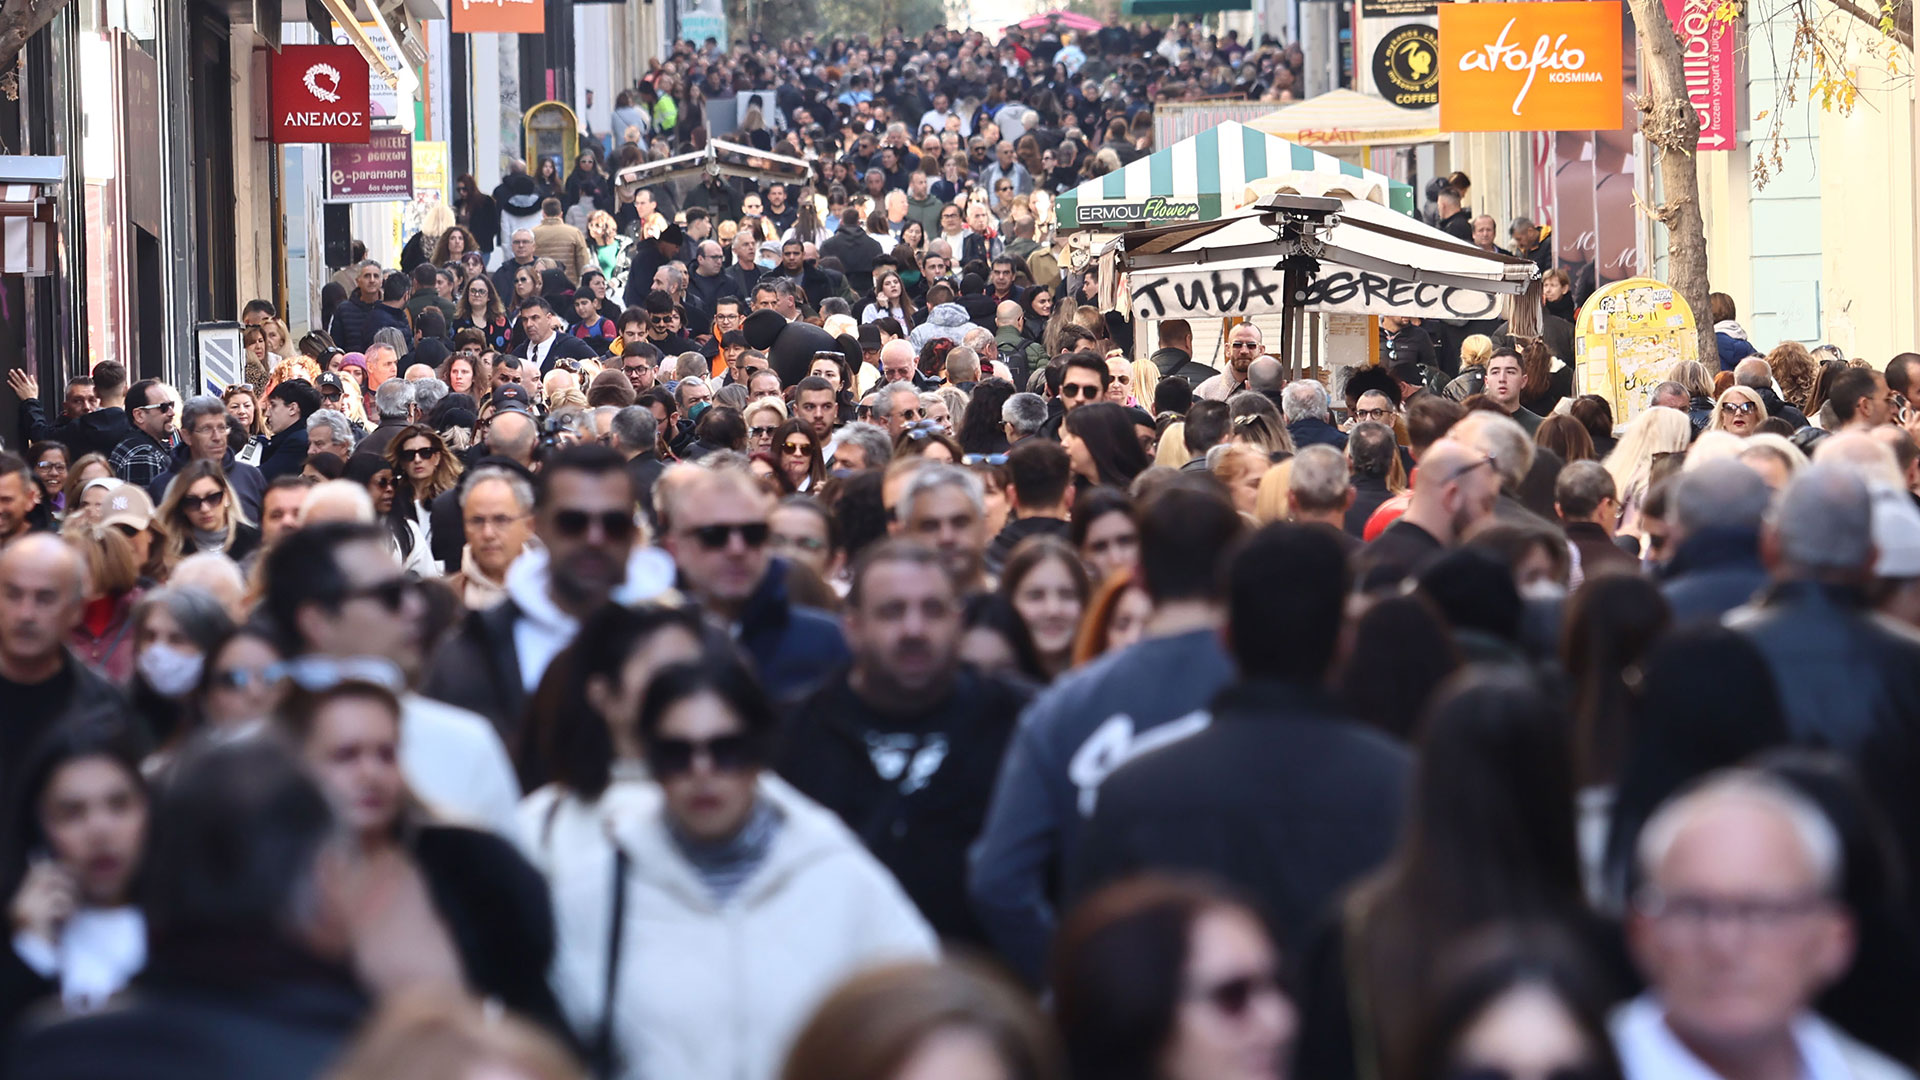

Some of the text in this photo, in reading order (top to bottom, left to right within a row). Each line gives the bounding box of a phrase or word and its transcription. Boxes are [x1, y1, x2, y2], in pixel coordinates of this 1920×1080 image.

[1711, 29, 1721, 53] juicy
[1711, 54, 1720, 63] &
[1549, 72, 1603, 83] KOSMIMA
[1711, 65, 1722, 97] yogurt
[1396, 93, 1437, 104] COFFEE
[284, 112, 362, 126] ΑΝΕΜΟΣ
[1711, 98, 1721, 131] frozen
[332, 169, 407, 185] e-paramana
[1080, 199, 1197, 220] ERMOU Flower
